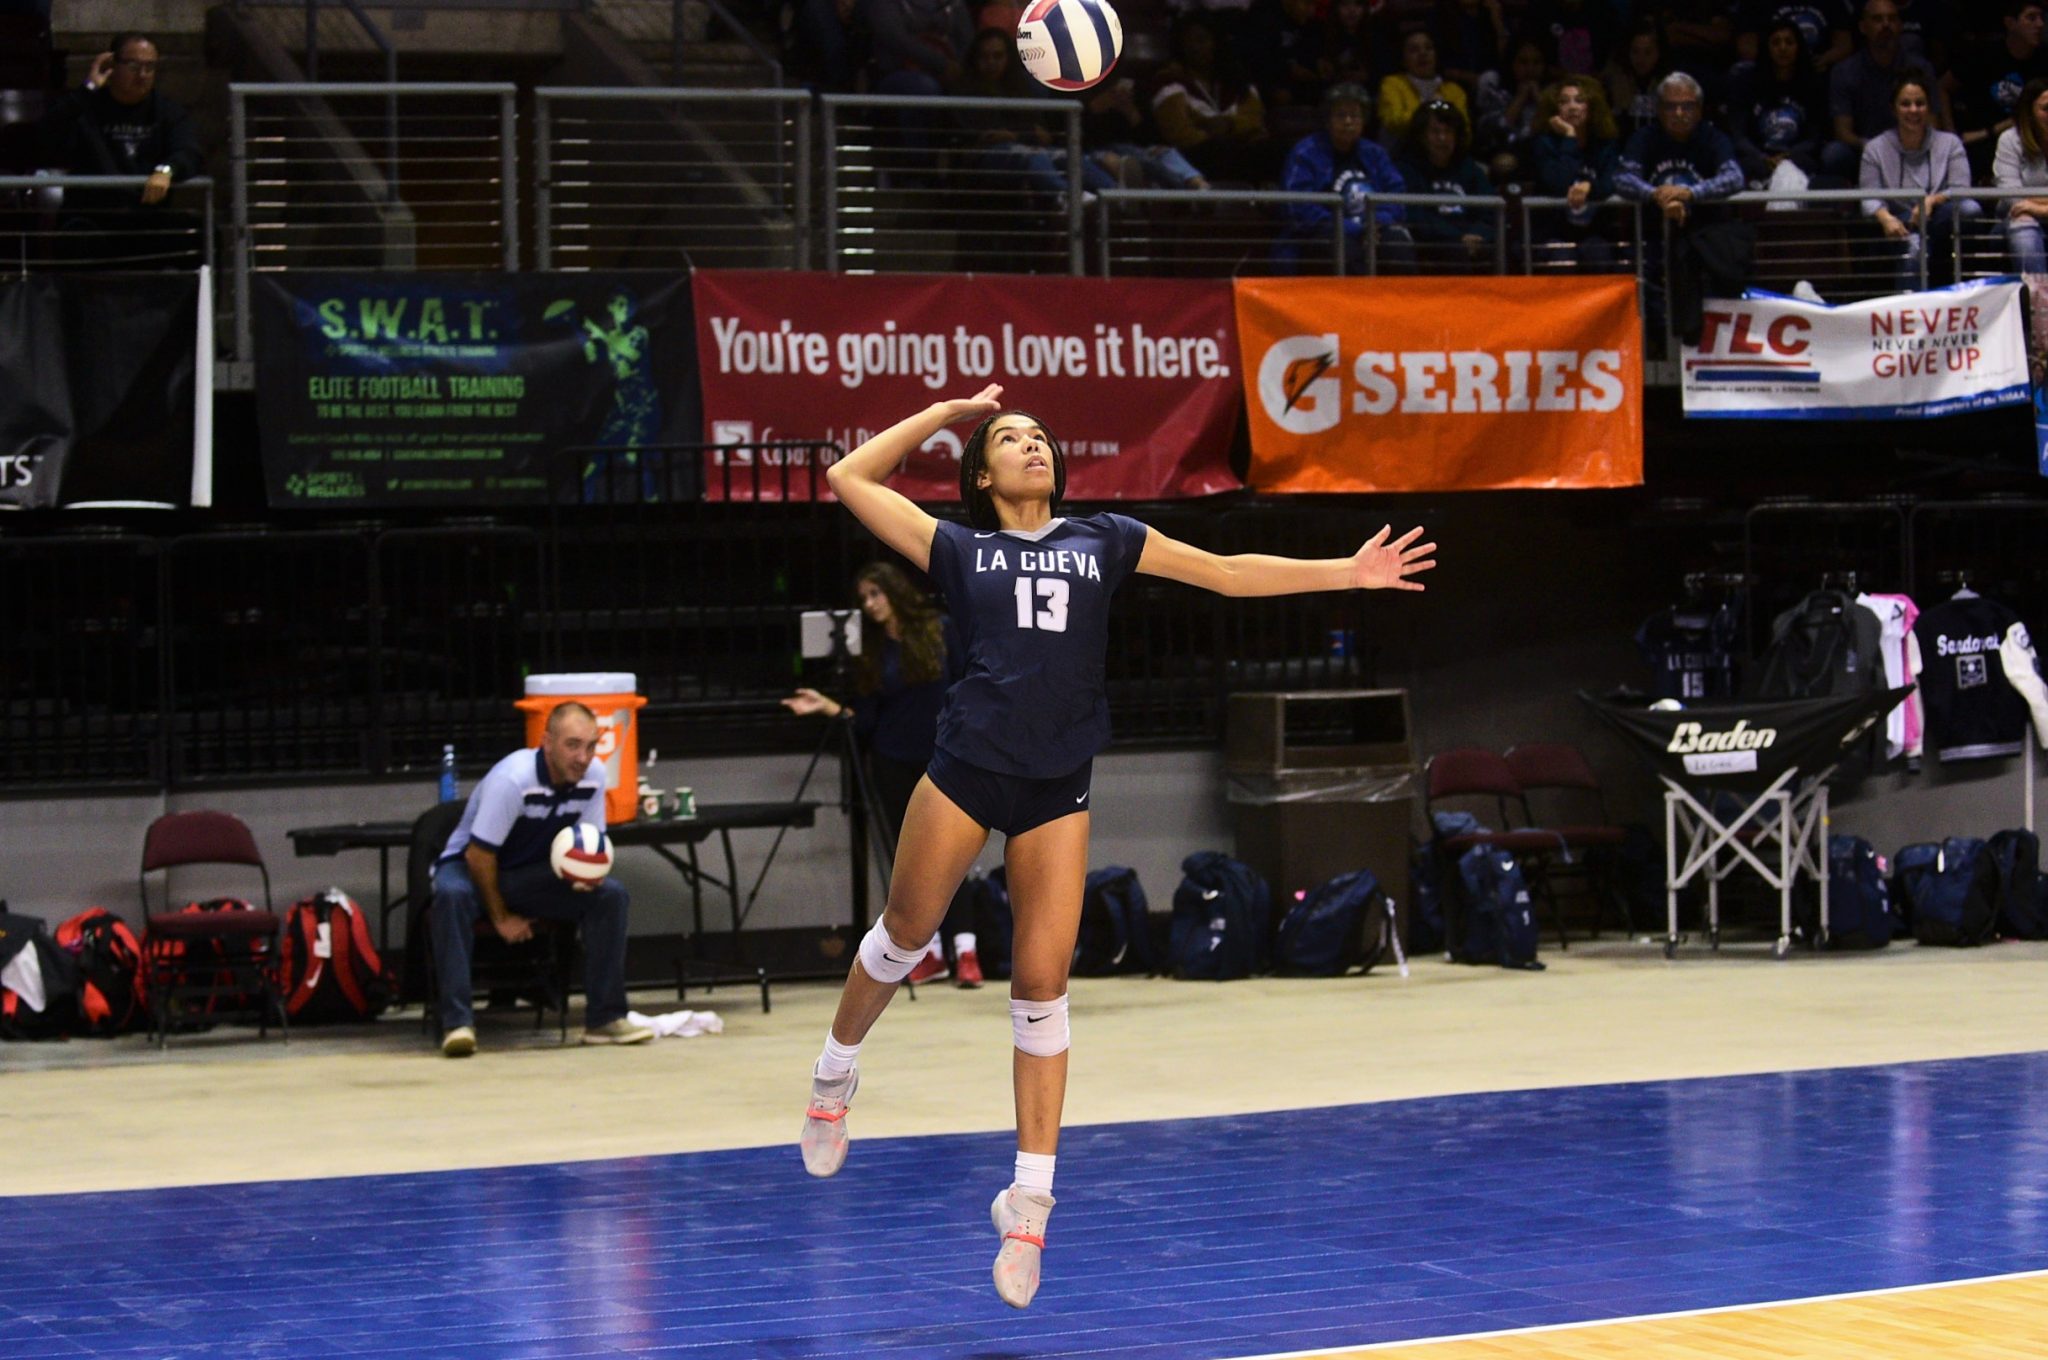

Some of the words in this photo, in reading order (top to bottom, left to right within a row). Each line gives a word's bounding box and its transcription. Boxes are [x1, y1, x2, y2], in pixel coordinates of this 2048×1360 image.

[319, 297, 499, 342] S.W.A.T.
[1697, 311, 1812, 356] TLC
[1871, 306, 1979, 336] NEVER
[710, 316, 829, 374] You're
[838, 321, 947, 389] going
[955, 326, 994, 378] to
[1003, 322, 1088, 378] love
[1095, 324, 1125, 378] it
[1133, 324, 1231, 379] here.
[1873, 338, 1925, 351] NEVER
[1932, 333, 1979, 348] NEVER
[1872, 350, 1938, 378] GIVE
[1946, 348, 1981, 371] UP
[308, 376, 354, 400] ELITE
[358, 376, 442, 400] FOOTBALL
[448, 376, 525, 400] TRAINING
[1257, 333, 1342, 435] G
[1352, 349, 1625, 416] SERIES
[975, 548, 1008, 573] LA
[1020, 550, 1101, 582] CUEVA
[1014, 576, 1070, 633] 13
[1667, 719, 1777, 753] Baden
